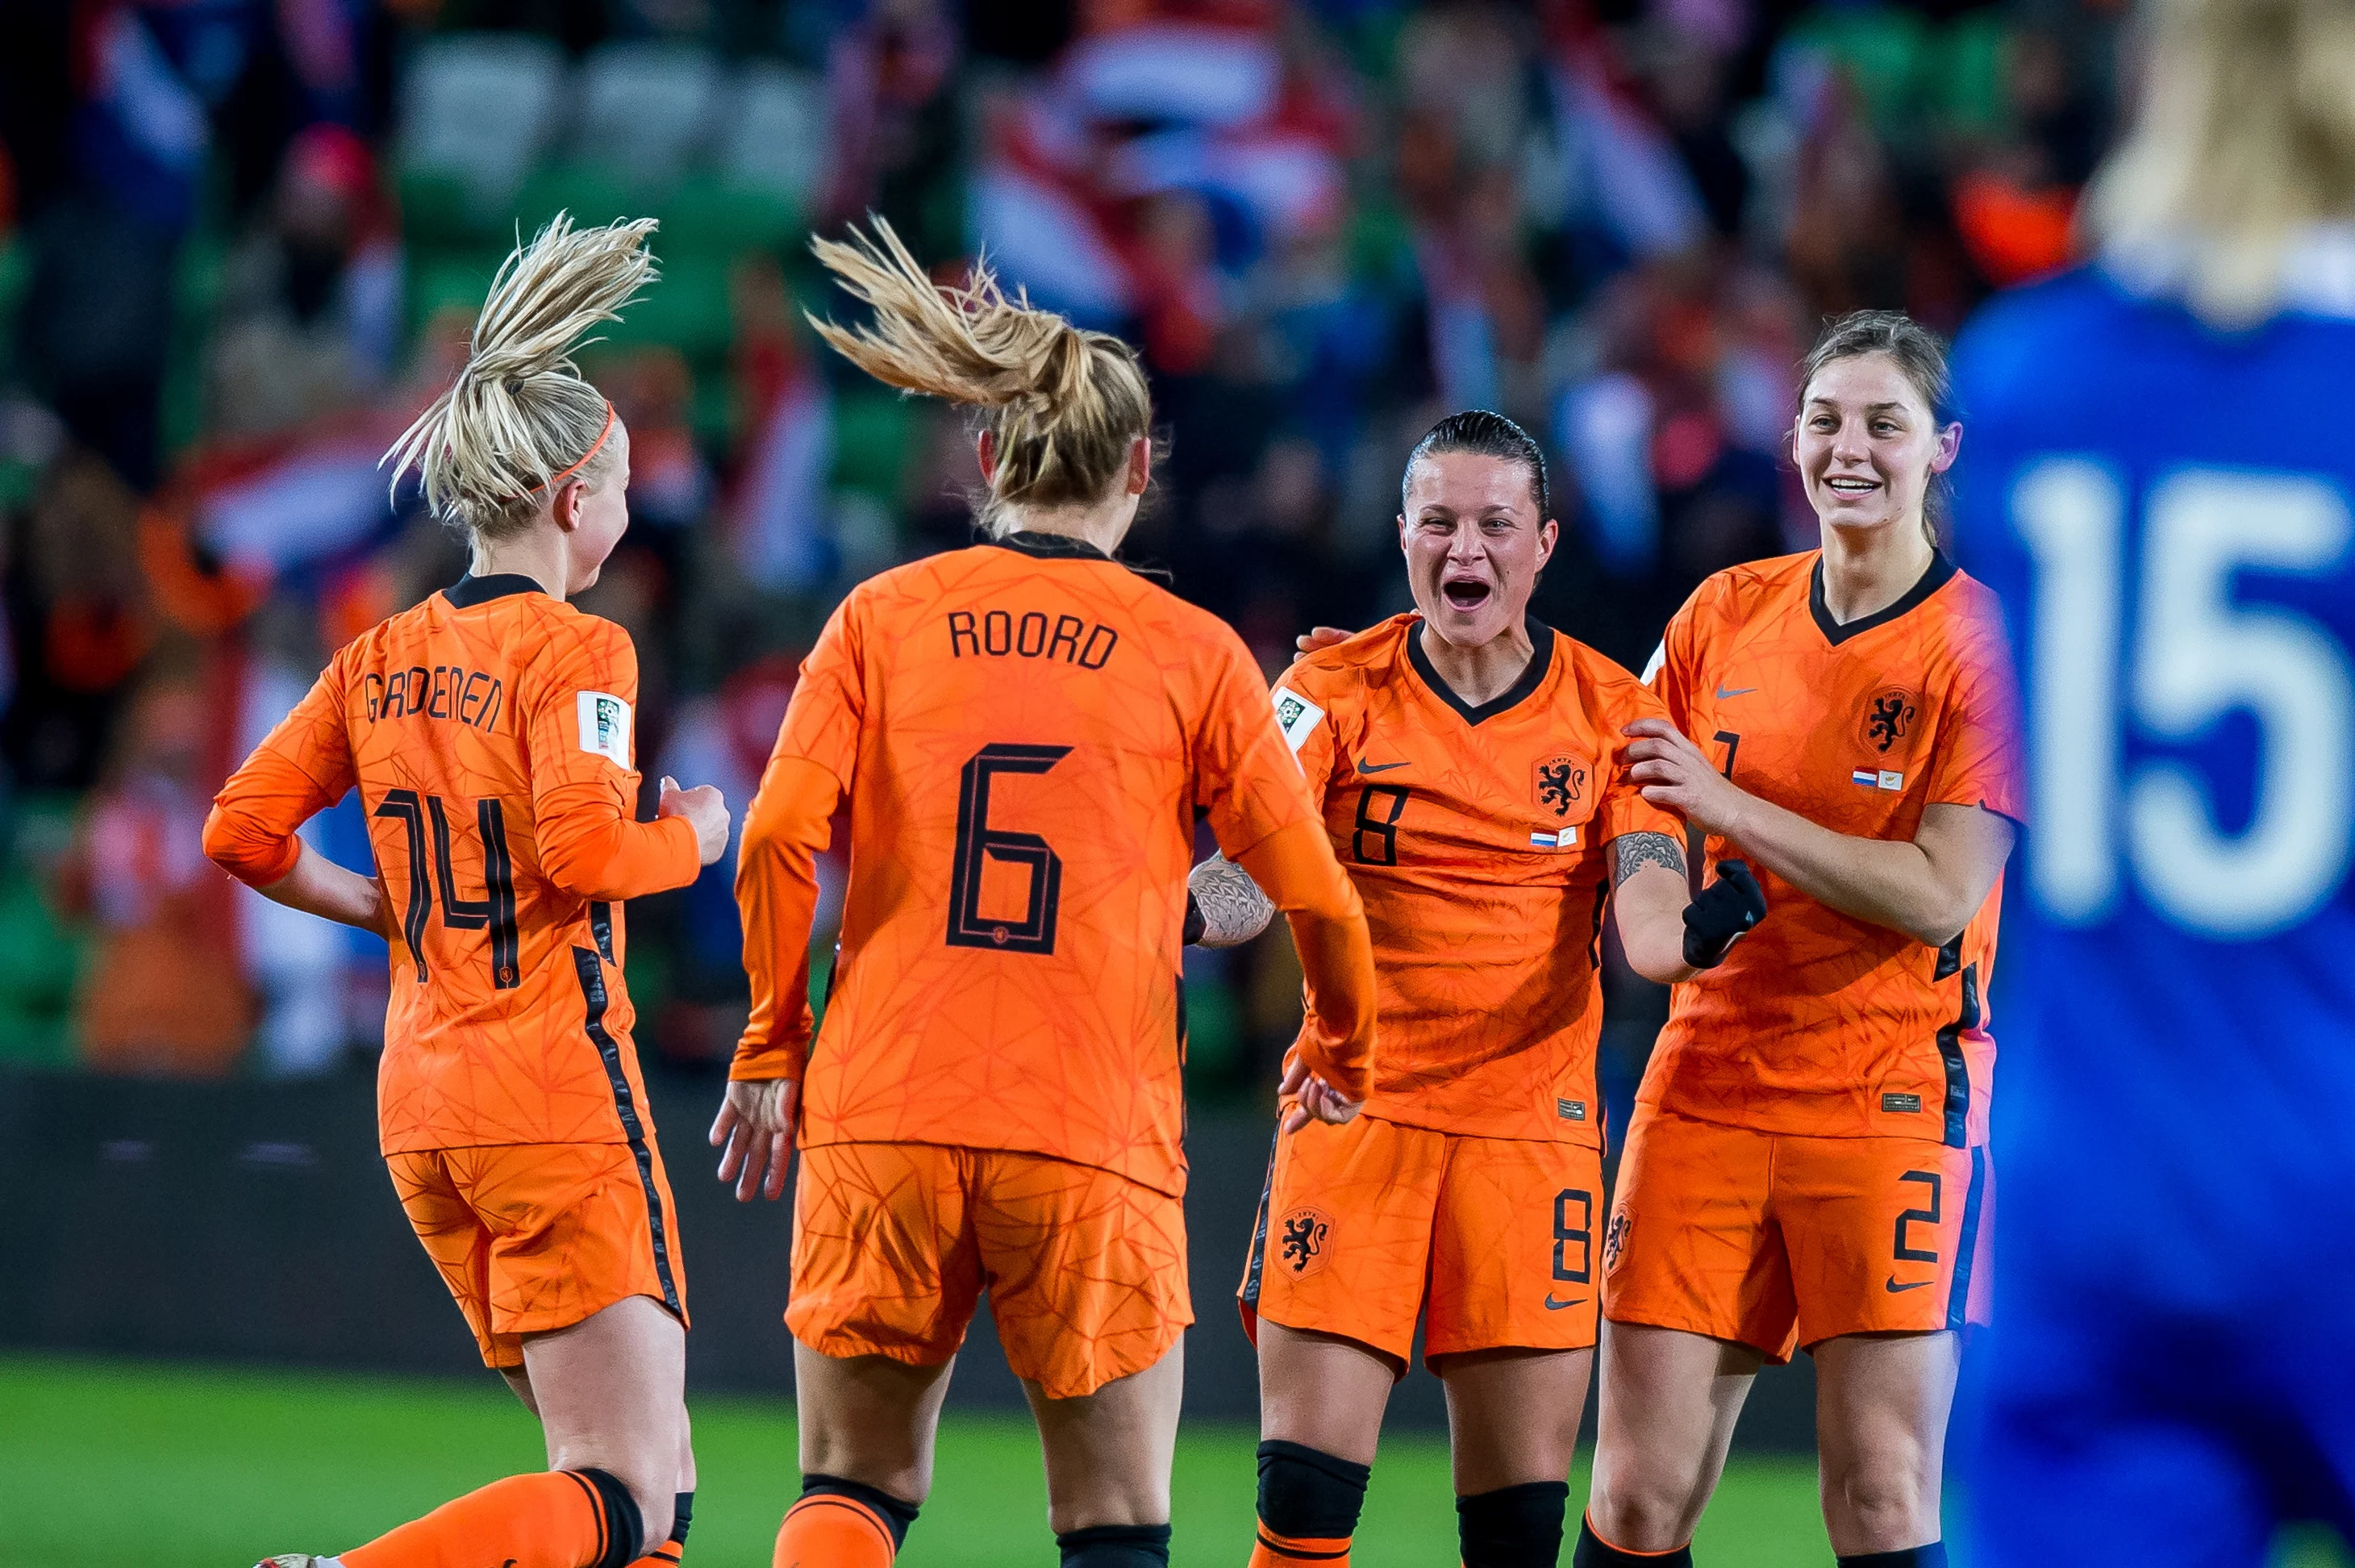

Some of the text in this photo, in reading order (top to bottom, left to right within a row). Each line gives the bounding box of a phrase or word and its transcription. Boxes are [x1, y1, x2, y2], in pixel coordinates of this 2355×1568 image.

[948, 610, 1119, 670] ROORD
[365, 665, 503, 733] GROENEN
[2010, 455, 2353, 937] 15
[945, 742, 1076, 956] 6
[1352, 782, 1413, 867] 8
[373, 788, 521, 990] 14
[1552, 1188, 1593, 1286] 8
[1893, 1170, 1942, 1264] 2
